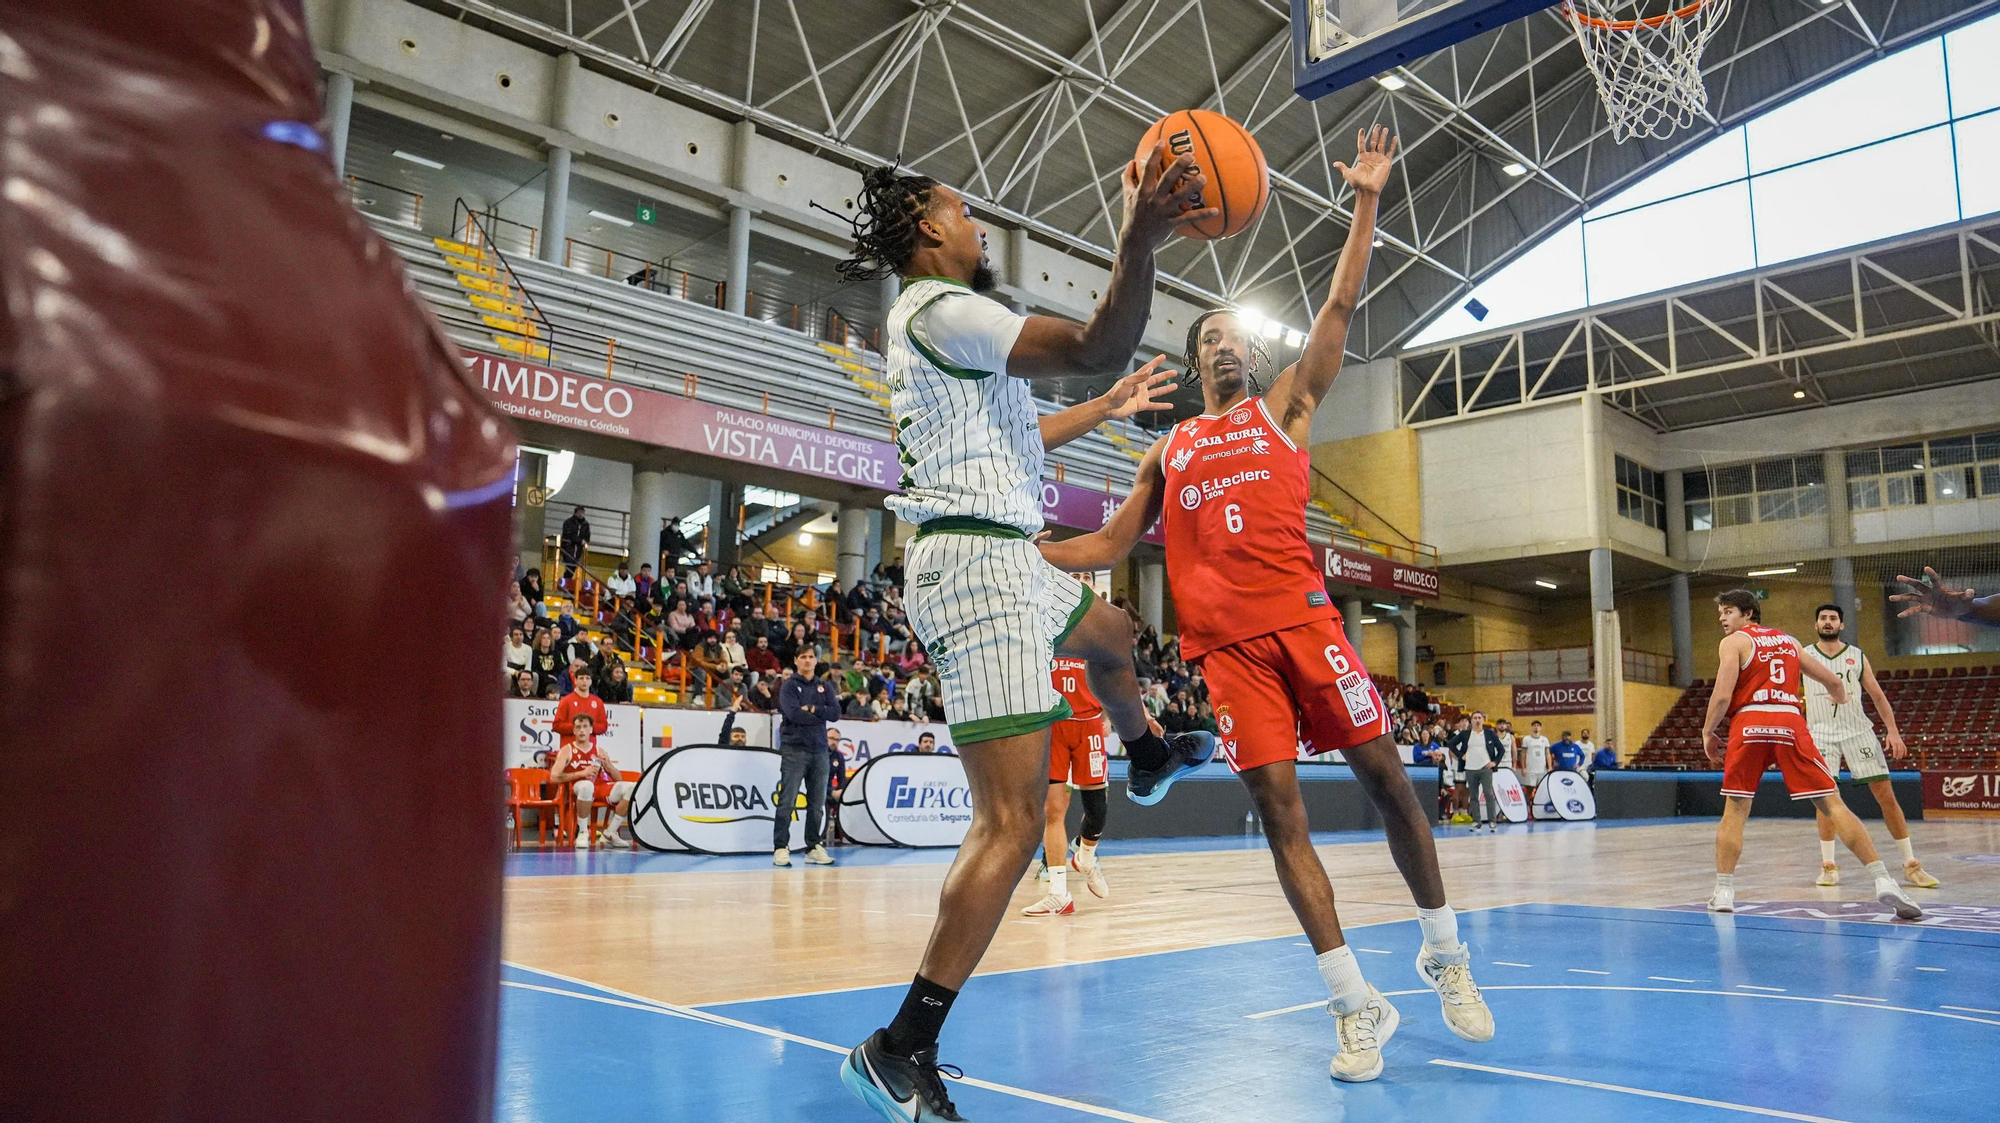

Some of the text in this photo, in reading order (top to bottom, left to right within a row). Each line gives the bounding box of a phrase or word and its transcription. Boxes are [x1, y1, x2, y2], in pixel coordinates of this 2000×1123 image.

[642, 209, 650, 221] 3
[482, 359, 633, 418] IMDECO
[528, 407, 542, 418] de
[543, 409, 589, 428] Deportes
[590, 418, 630, 435] Córdoba
[716, 411, 873, 454] PALACIO MUNICIPAL DEPORTES
[1194, 426, 1267, 449] CAJA RURAL
[703, 424, 886, 485] VISTA ALEGRE
[1201, 469, 1271, 494] E.Leclerc
[1205, 489, 1224, 501] LEÓN
[1224, 503, 1244, 534] 6
[1343, 558, 1372, 572] Diputación
[916, 571, 941, 585] PRO
[1343, 570, 1372, 583] de Córdoba
[1403, 568, 1438, 590] IMDECO
[1324, 644, 1350, 675] 6
[1769, 658, 1786, 685] 5
[1061, 676, 1076, 693] 10
[1340, 673, 1361, 691] BUN
[528, 705, 549, 717] San
[1353, 706, 1376, 724] HAM
[1087, 734, 1102, 751] 10
[674, 782, 769, 810] PiEDRA
[1943, 801, 1980, 809] Instituto
[928, 813, 939, 822] de
[940, 813, 971, 823] Seguros
